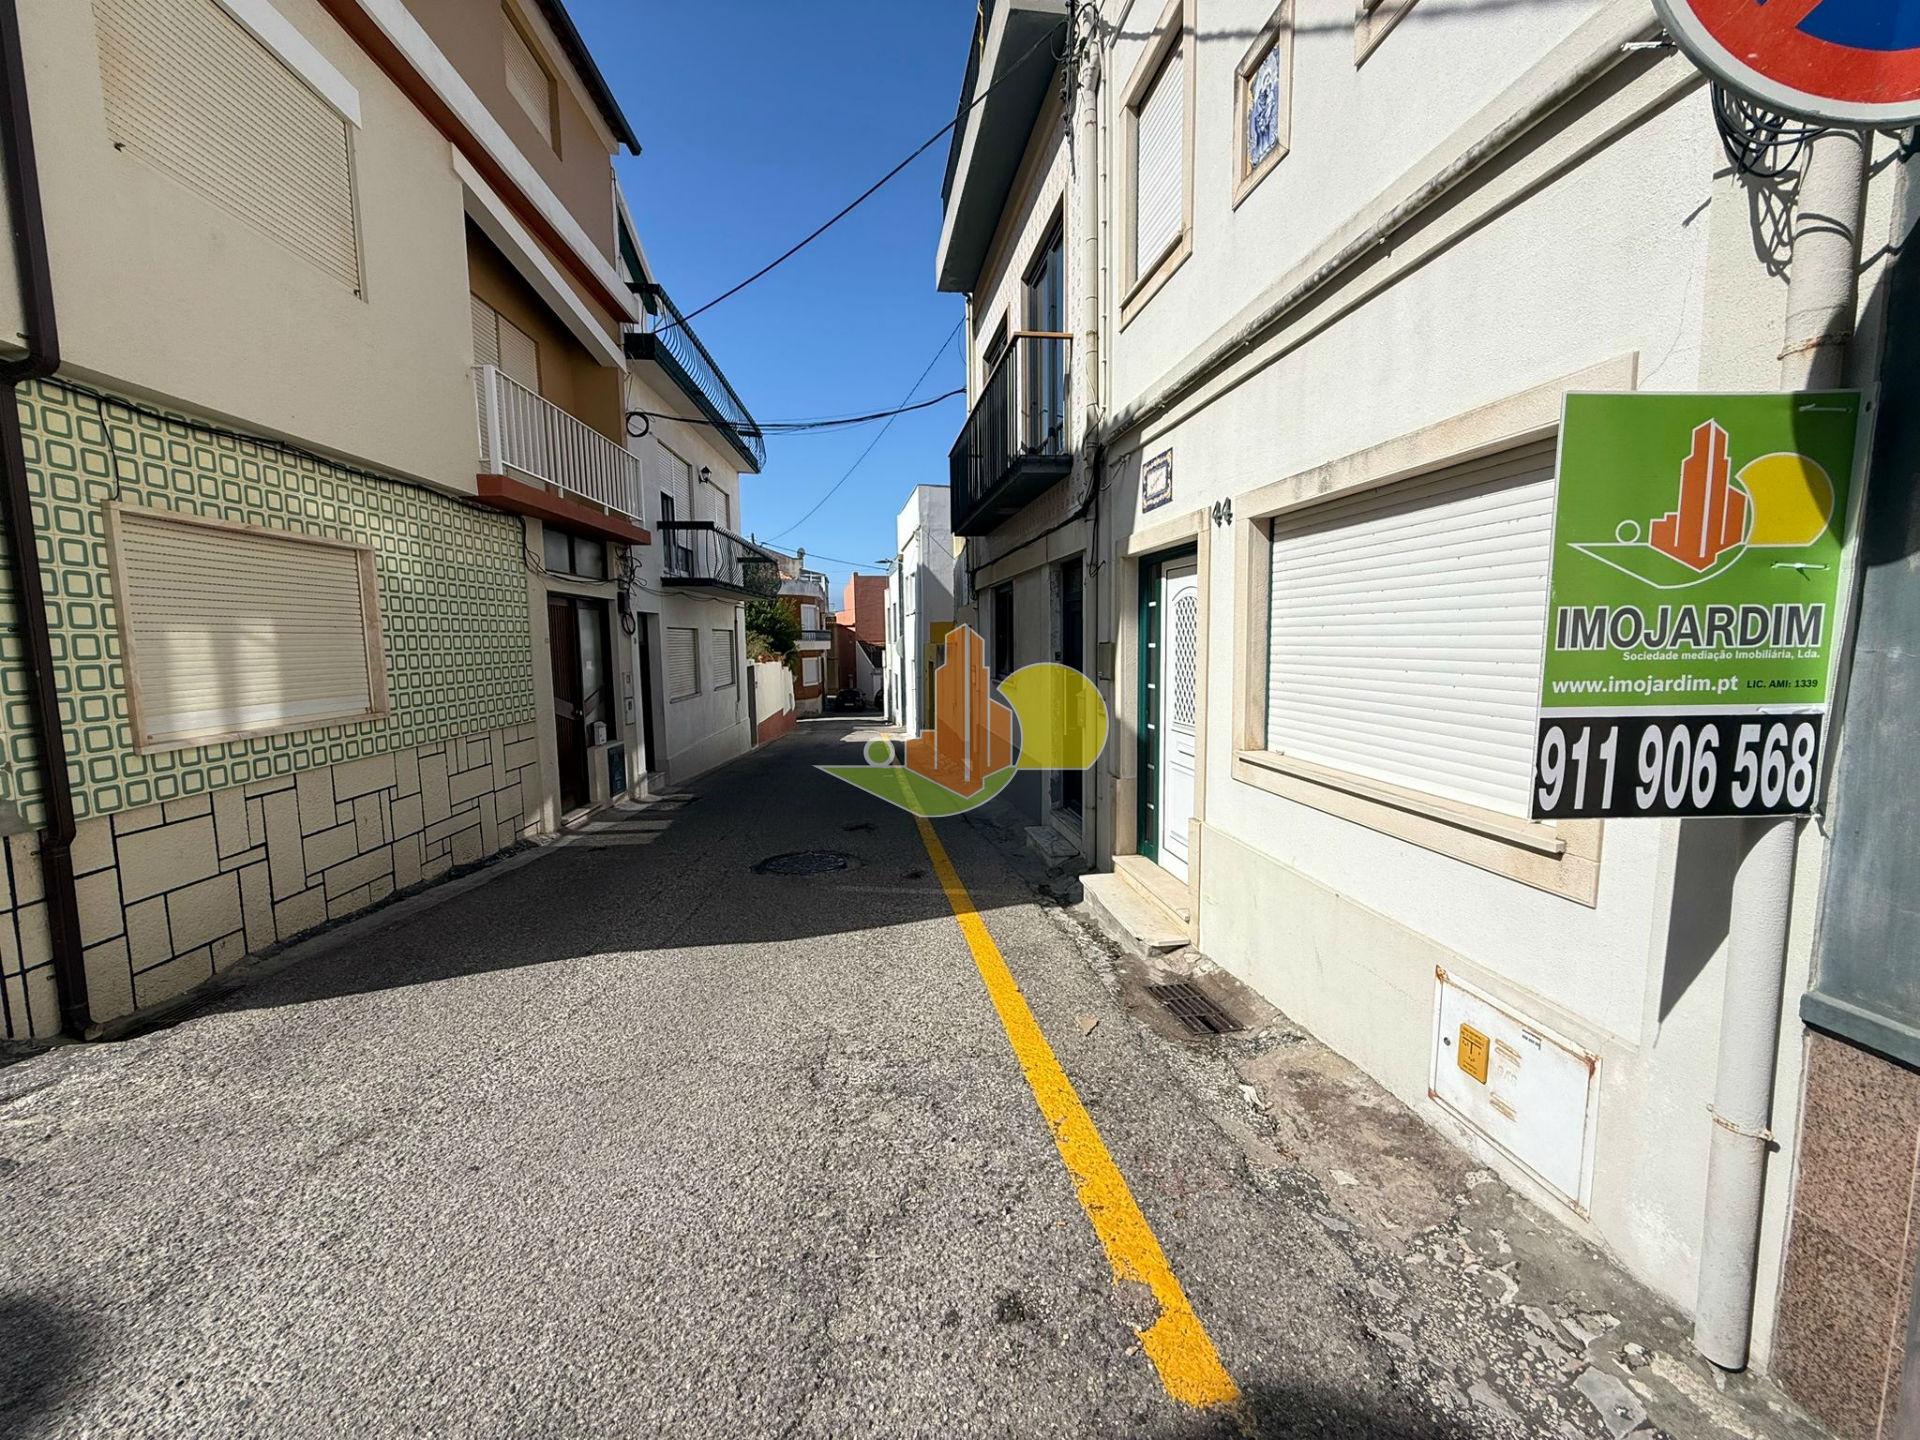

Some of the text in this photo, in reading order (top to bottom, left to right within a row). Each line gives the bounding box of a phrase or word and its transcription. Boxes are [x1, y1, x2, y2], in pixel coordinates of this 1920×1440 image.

[1212, 497, 1233, 528] 44
[1555, 604, 1825, 651] IMOJARDIM
[1623, 649, 1820, 661] Sociedade mediação Imobiliária, Lda.
[1552, 675, 1738, 696] www.imojardim.pt
[1746, 679, 1818, 688] LIC. AMI: 1339
[1538, 722, 1816, 810] 911 906 568
